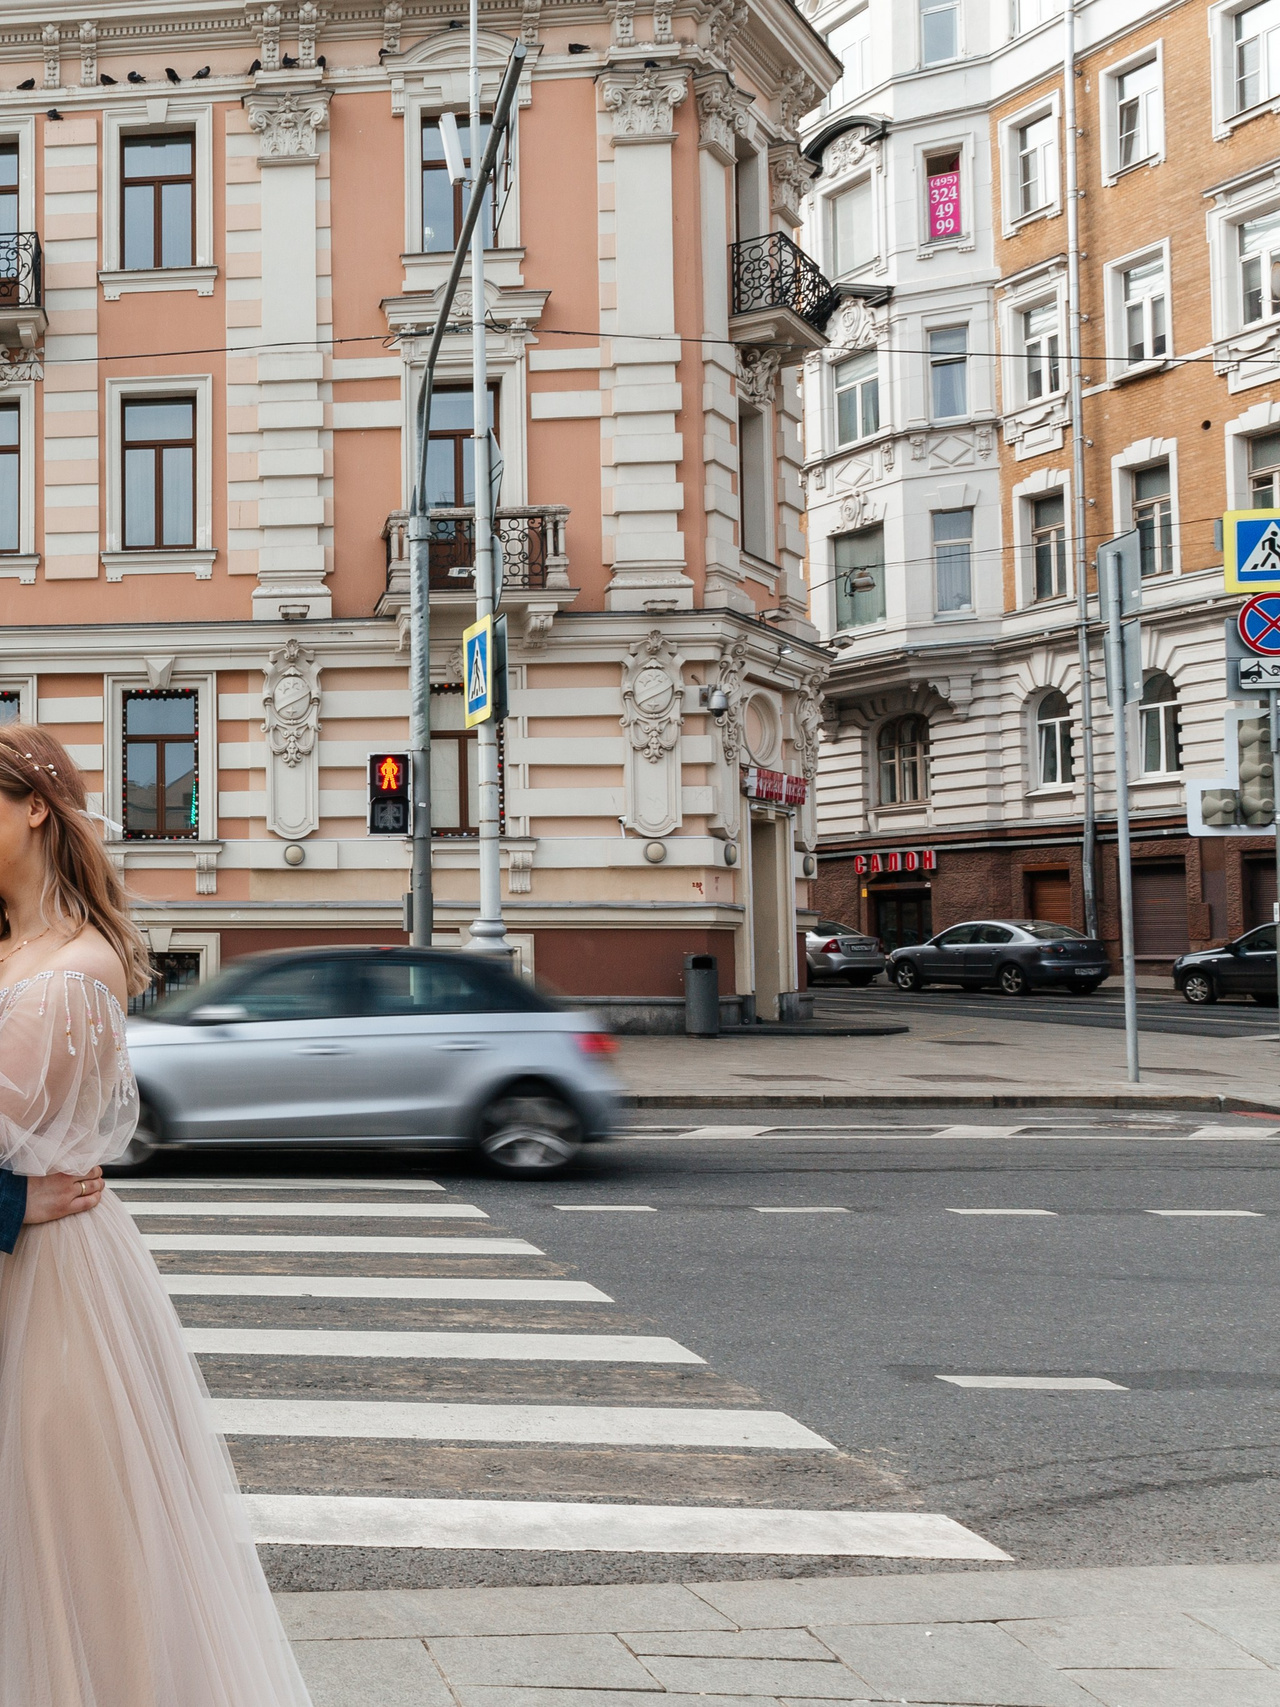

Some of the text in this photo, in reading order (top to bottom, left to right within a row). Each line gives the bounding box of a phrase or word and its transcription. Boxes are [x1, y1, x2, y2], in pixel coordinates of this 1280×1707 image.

[930, 175, 957, 188] (495)
[931, 185, 958, 204] 324
[935, 202, 954, 218] 49
[936, 218, 954, 235] 99
[854, 850, 936, 875] САЛОН
